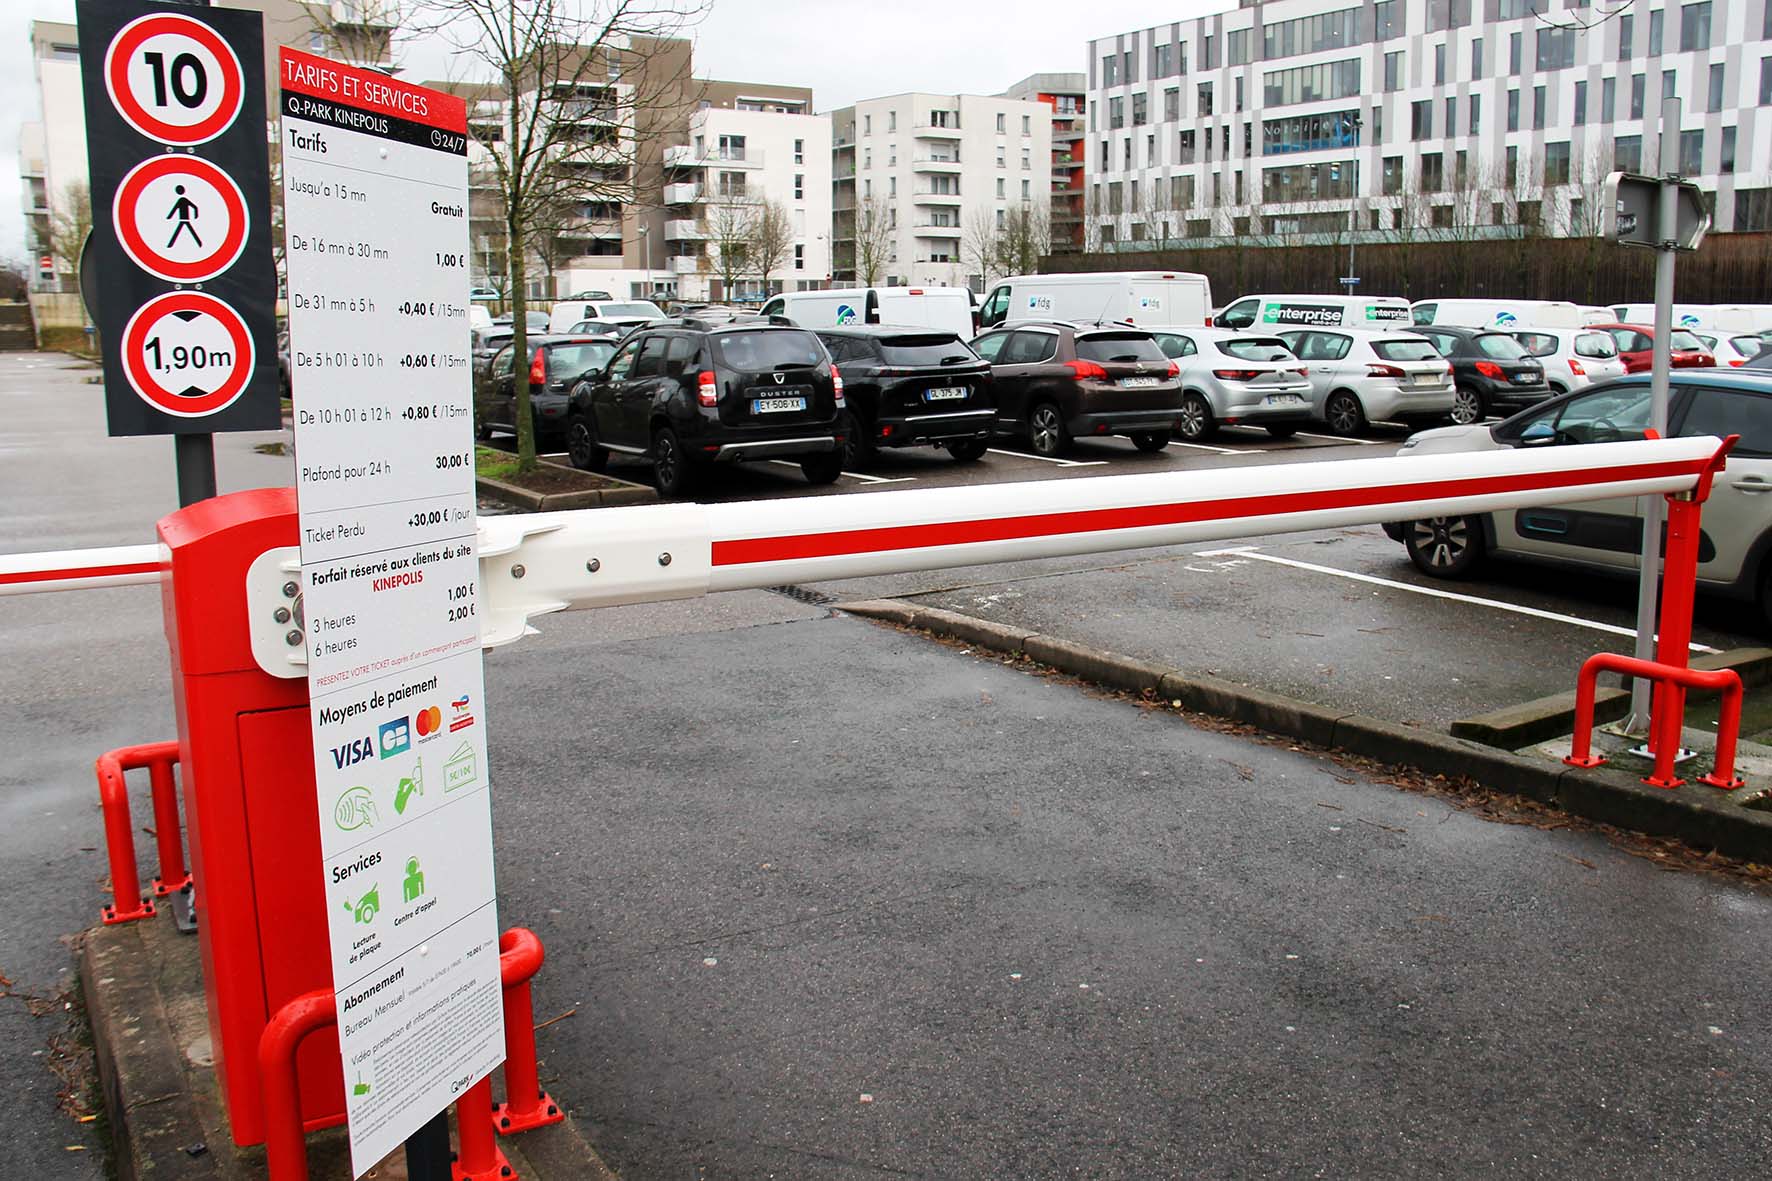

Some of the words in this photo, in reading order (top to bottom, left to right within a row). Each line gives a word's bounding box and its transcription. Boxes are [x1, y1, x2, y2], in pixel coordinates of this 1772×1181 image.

[145, 52, 208, 109] 10
[285, 59, 338, 93] TARIFS
[343, 77, 360, 97] ET
[365, 82, 428, 116] SERVICES
[288, 97, 331, 121] Q-PARK
[335, 108, 388, 134] KINEPOLIS
[289, 129, 327, 153] Tarifs
[442, 134, 464, 151] 24/7
[335, 183, 347, 199] 15
[351, 191, 366, 202] mn
[432, 202, 463, 218] Gratuit
[293, 235, 308, 250] De
[312, 238, 325, 252] 16
[329, 244, 344, 255] mn
[348, 243, 354, 256] à
[358, 243, 370, 258] 30
[374, 249, 388, 259] mn
[436, 253, 456, 267] 1,00
[459, 255, 464, 267] €
[295, 294, 309, 308] De
[313, 295, 326, 310] 31
[331, 300, 346, 311] mn
[350, 299, 356, 311] à
[360, 299, 365, 312] 5
[369, 299, 375, 312] h
[399, 302, 426, 316] +0,40
[430, 303, 434, 315] €
[438, 304, 465, 317] /15mn
[1266, 307, 1342, 323] enterprise
[1367, 308, 1408, 320] enterprise
[145, 337, 232, 375] 1,90m
[297, 352, 312, 367] De
[316, 353, 322, 366] 5
[326, 353, 332, 367] h
[336, 352, 347, 367] 01
[352, 354, 358, 367] à
[362, 353, 374, 367] 10
[378, 354, 383, 367] h
[400, 354, 427, 368] +0,60
[431, 354, 436, 367] €
[439, 355, 466, 368] /15mn
[300, 410, 315, 425] De
[319, 410, 332, 423] 10
[335, 410, 341, 423] h
[345, 409, 356, 422] 01
[361, 410, 367, 422] à
[371, 408, 382, 421] 12
[385, 407, 391, 421] h
[402, 406, 429, 420] +0,80
[432, 405, 437, 418] €
[441, 405, 468, 419] /15mn
[436, 455, 461, 469] 30,00
[464, 453, 469, 466] €
[303, 465, 341, 482] Plafond
[345, 467, 366, 481] pour
[369, 462, 381, 475] 24
[385, 461, 391, 474] h
[408, 511, 440, 528] +30,00
[444, 509, 448, 521] €
[451, 508, 470, 524] /jour
[306, 528, 335, 543] Ticket
[338, 522, 365, 538] Perdu
[312, 568, 347, 585] Forfait
[351, 560, 388, 578] réservé
[391, 560, 409, 570] aux
[412, 550, 440, 566] clients
[443, 547, 454, 560] du
[457, 544, 471, 556] site
[373, 571, 423, 592] KINEPOLIS
[448, 585, 467, 601] 1,00
[470, 583, 474, 596] €
[449, 606, 468, 622] 2,00
[470, 603, 475, 616] €
[313, 619, 320, 633] 3
[324, 614, 356, 631] heures
[315, 642, 321, 657] 6
[325, 637, 357, 654] heures
[319, 701, 366, 726] Moyens
[370, 691, 384, 709] de
[388, 676, 438, 708] paiement
[382, 725, 408, 750] CB
[330, 736, 374, 770] VISA
[333, 851, 382, 883] Services
[394, 911, 414, 927] Centre
[352, 932, 376, 950] Lecture
[350, 953, 358, 964] de
[360, 941, 381, 960] plaque
[343, 967, 404, 1012] Abonnement
[345, 1013, 372, 1038] Bureau
[375, 989, 405, 1018] Mensuel
[351, 1046, 371, 1065] Vidéo
[373, 1025, 405, 1053] protection
[406, 1018, 411, 1031] et
